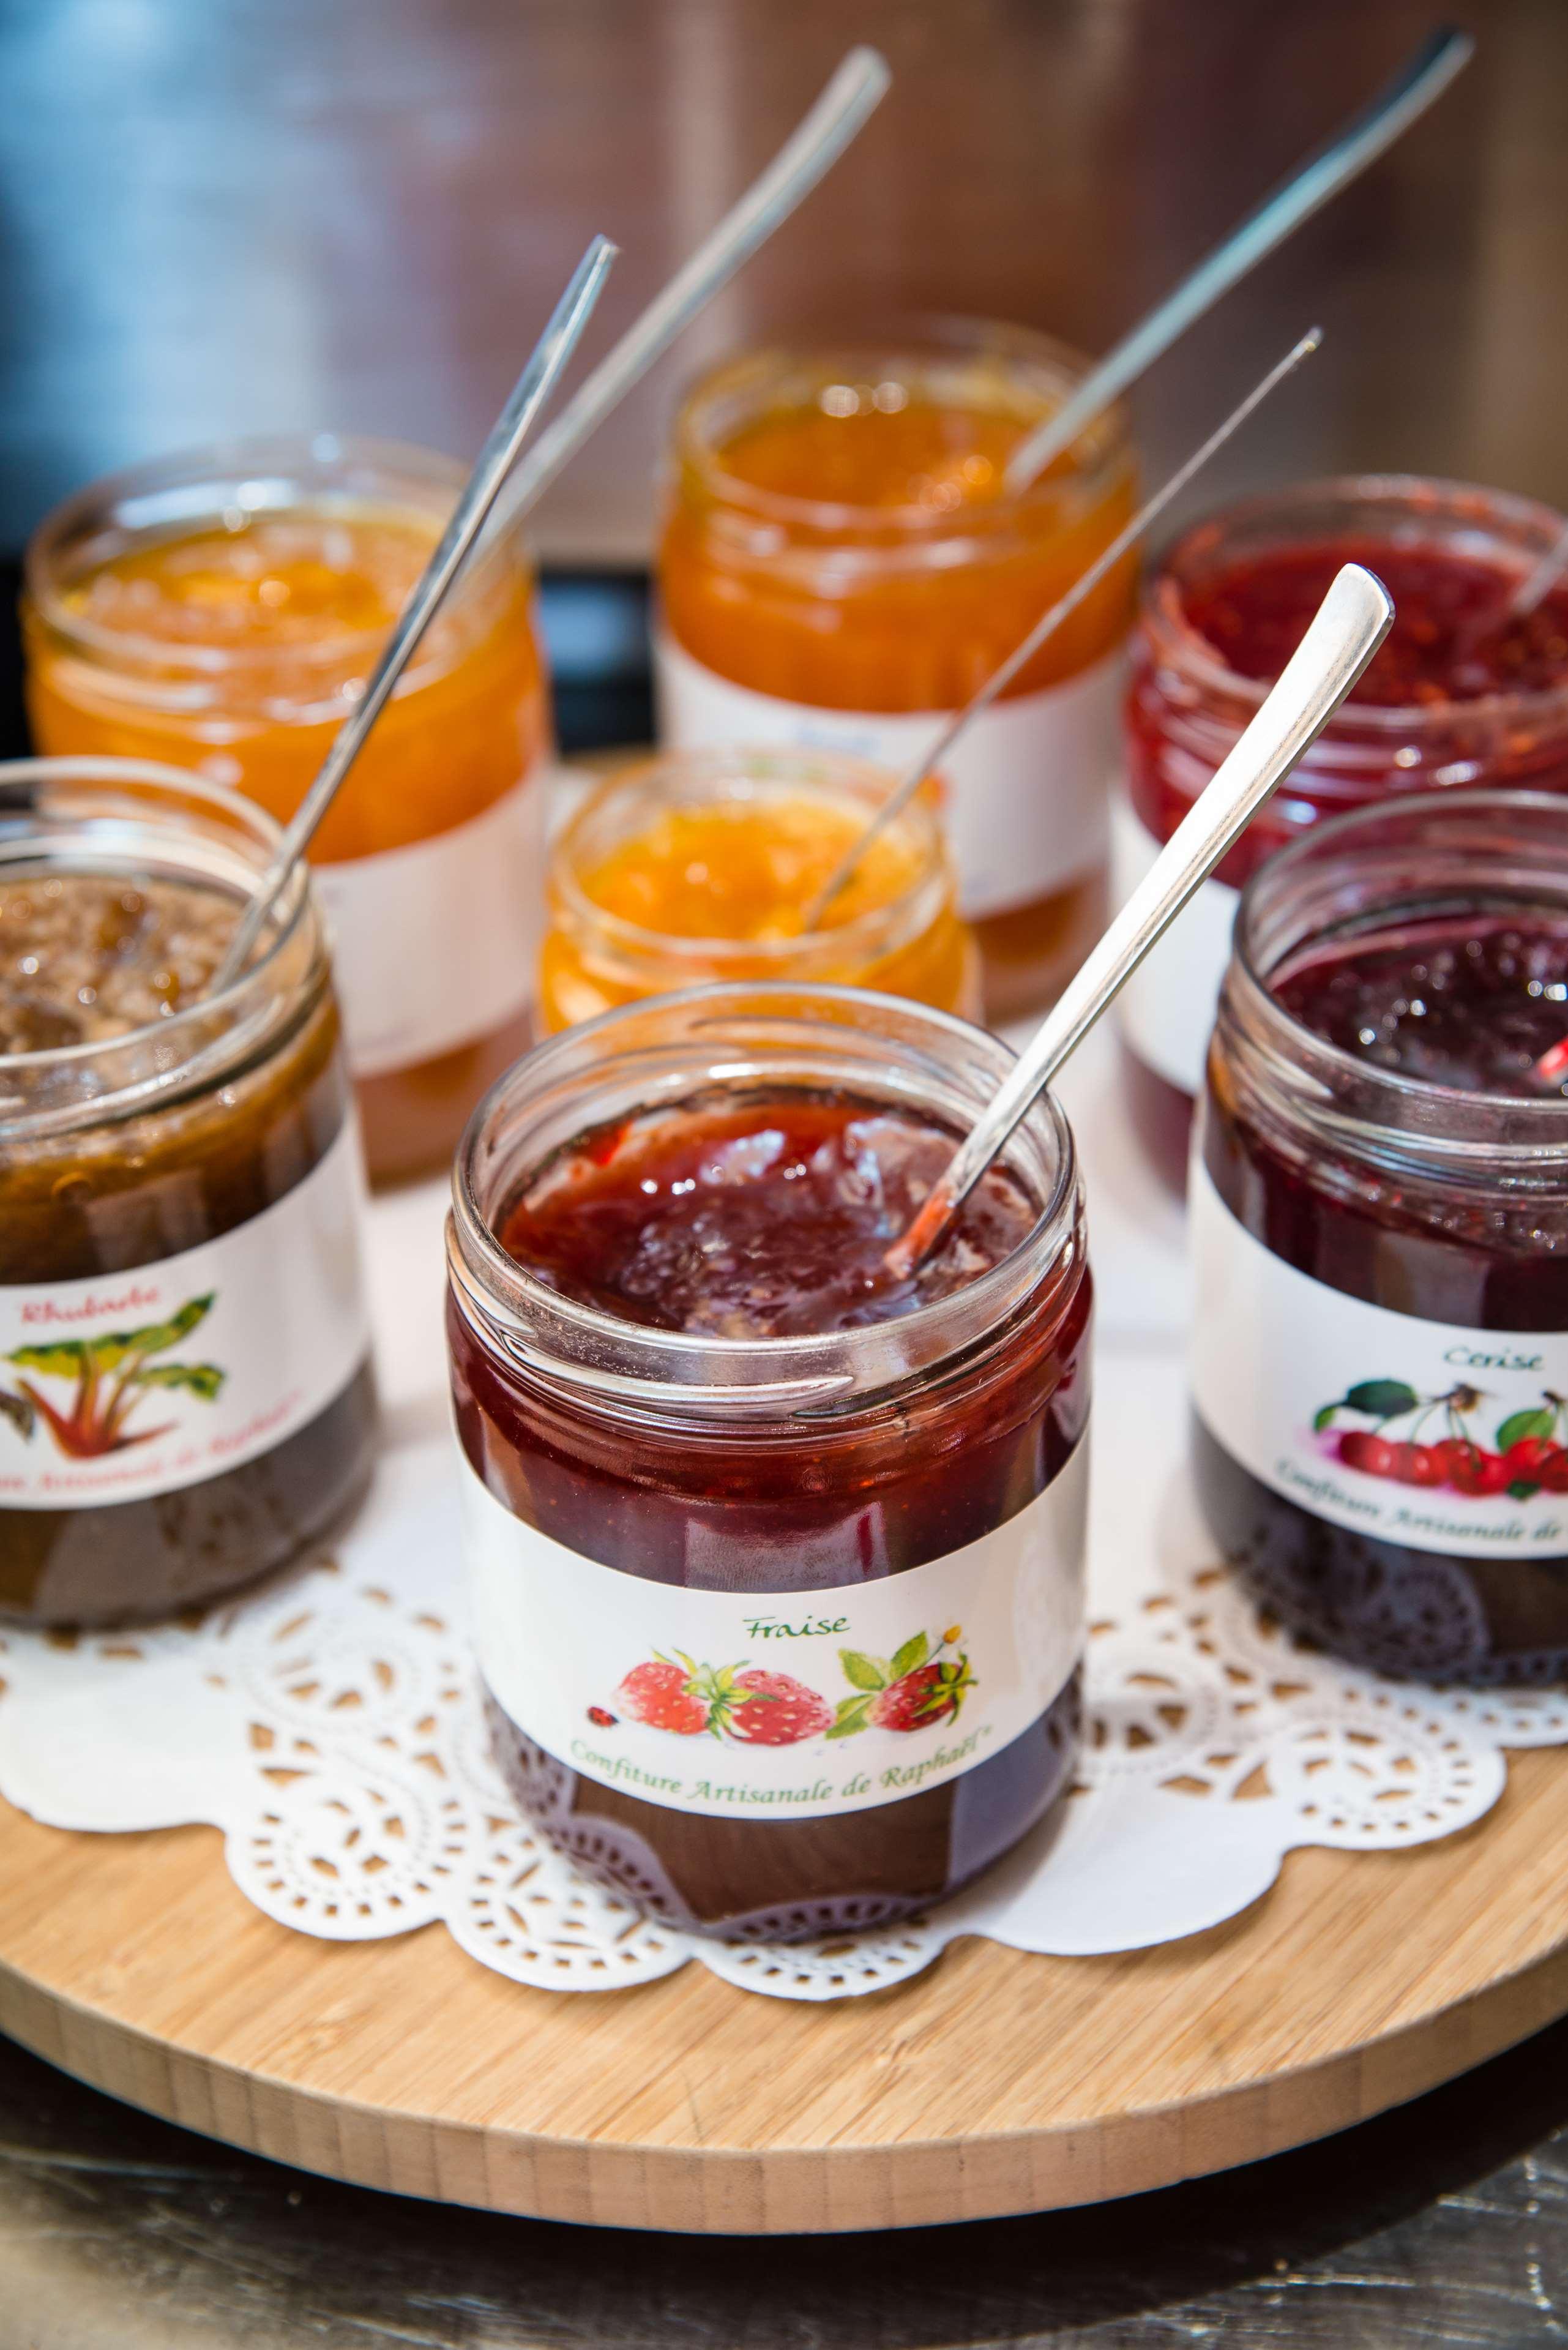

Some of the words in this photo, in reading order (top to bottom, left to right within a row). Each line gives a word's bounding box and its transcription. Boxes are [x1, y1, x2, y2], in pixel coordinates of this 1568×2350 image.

[1443, 1344, 1545, 1371] Cerise
[742, 1615, 851, 1639] Fraise
[570, 1739, 682, 1793] Confiture
[685, 1778, 834, 1803] Artisanale
[841, 1772, 872, 1797] de
